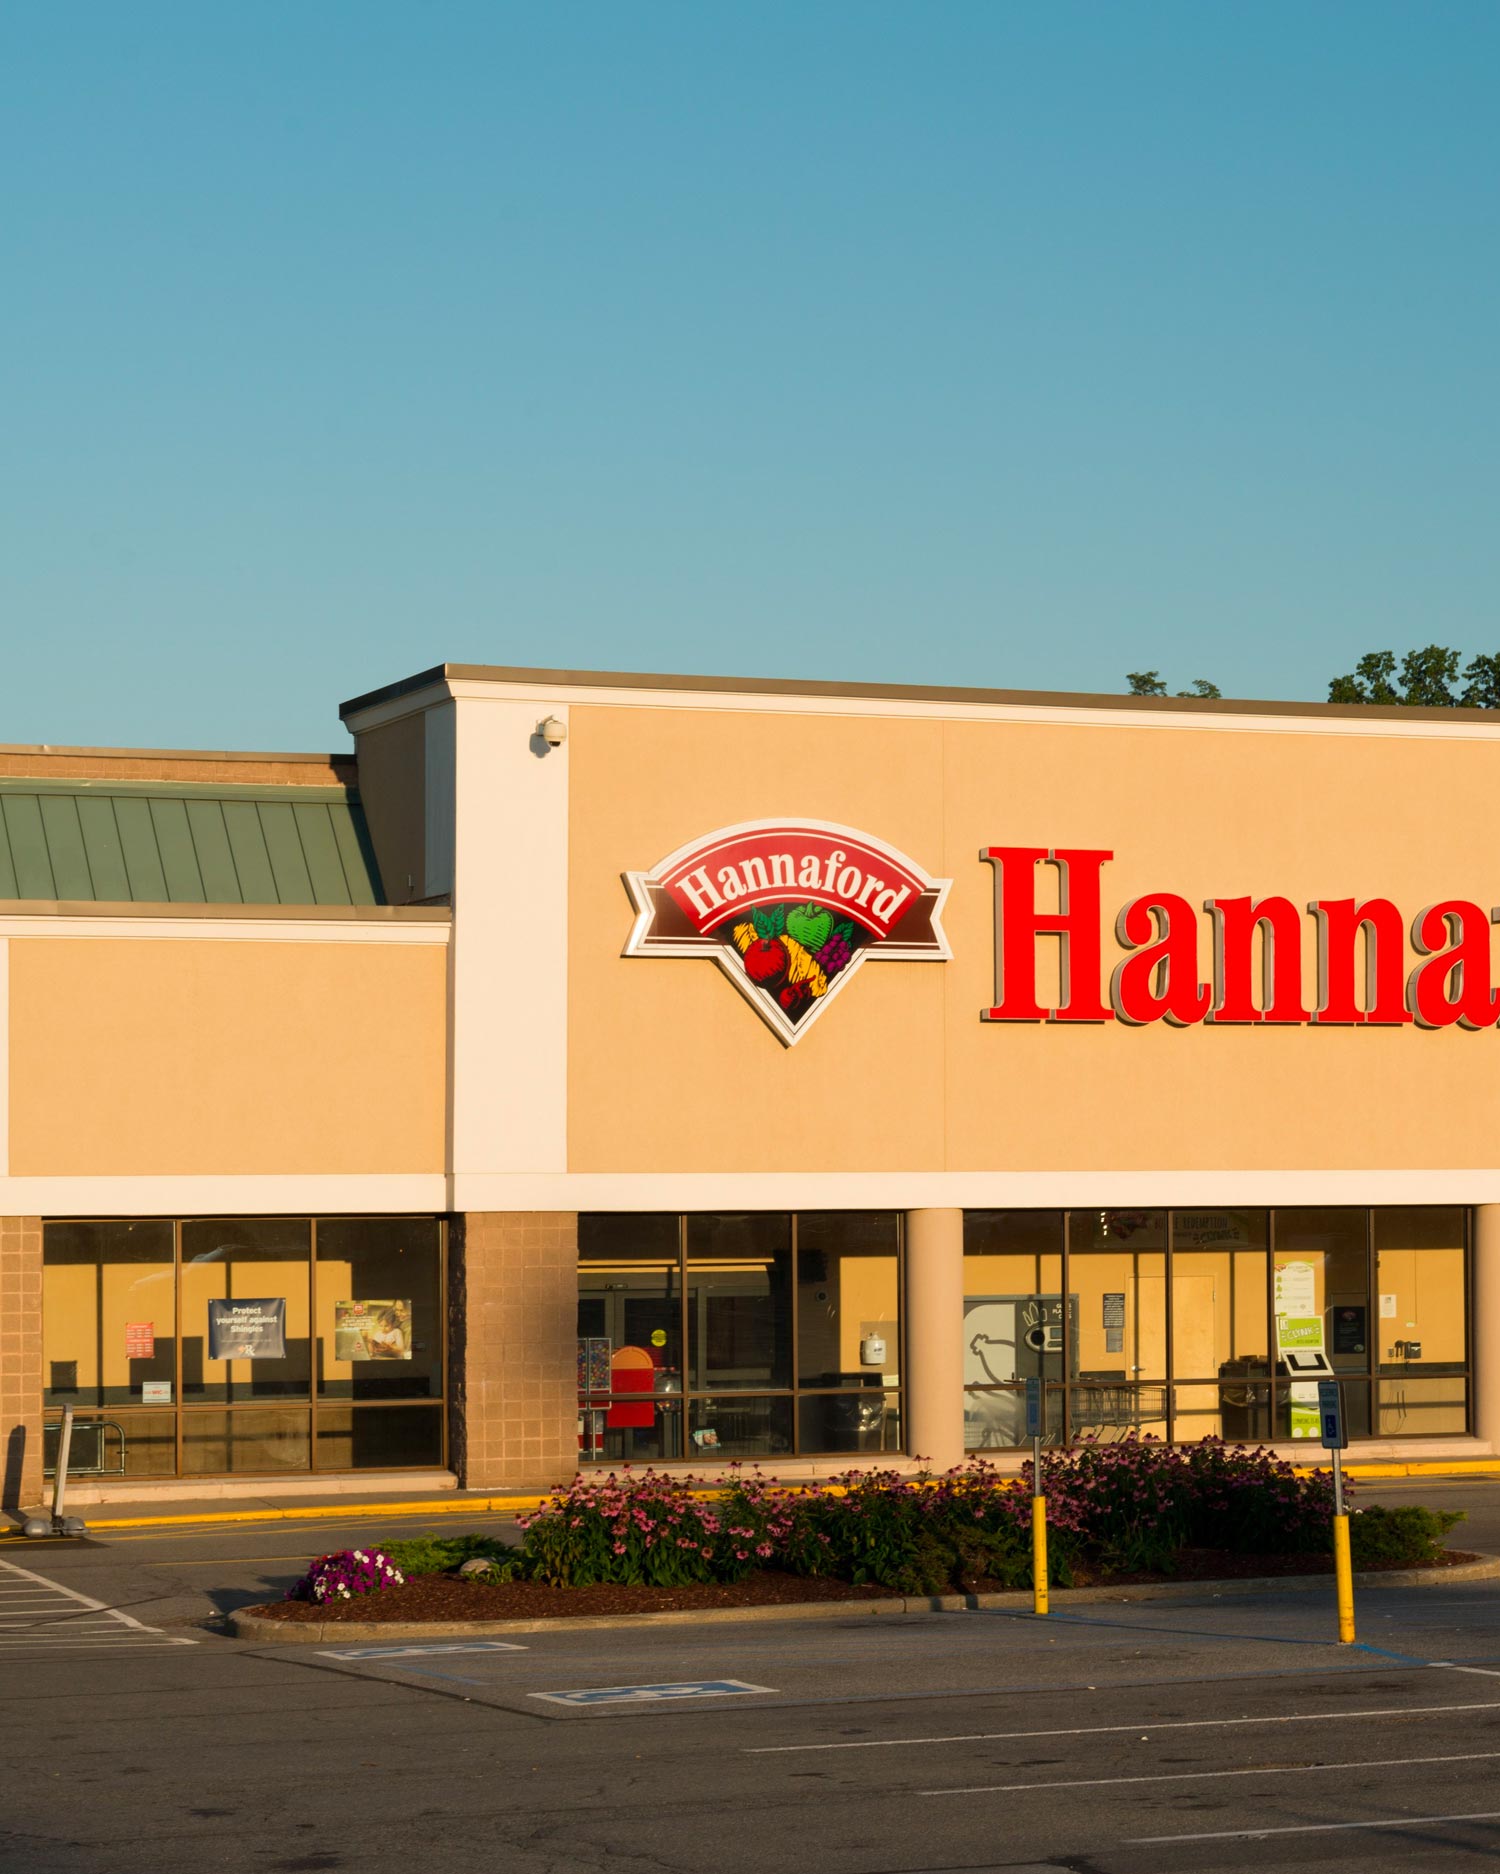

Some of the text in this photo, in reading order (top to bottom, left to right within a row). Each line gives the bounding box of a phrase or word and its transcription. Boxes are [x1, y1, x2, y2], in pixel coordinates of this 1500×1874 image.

[674, 850, 913, 925] Hannaford
[232, 1306, 262, 1315] Protect
[216, 1315, 278, 1326] yourself against
[230, 1325, 264, 1334] Shingles
